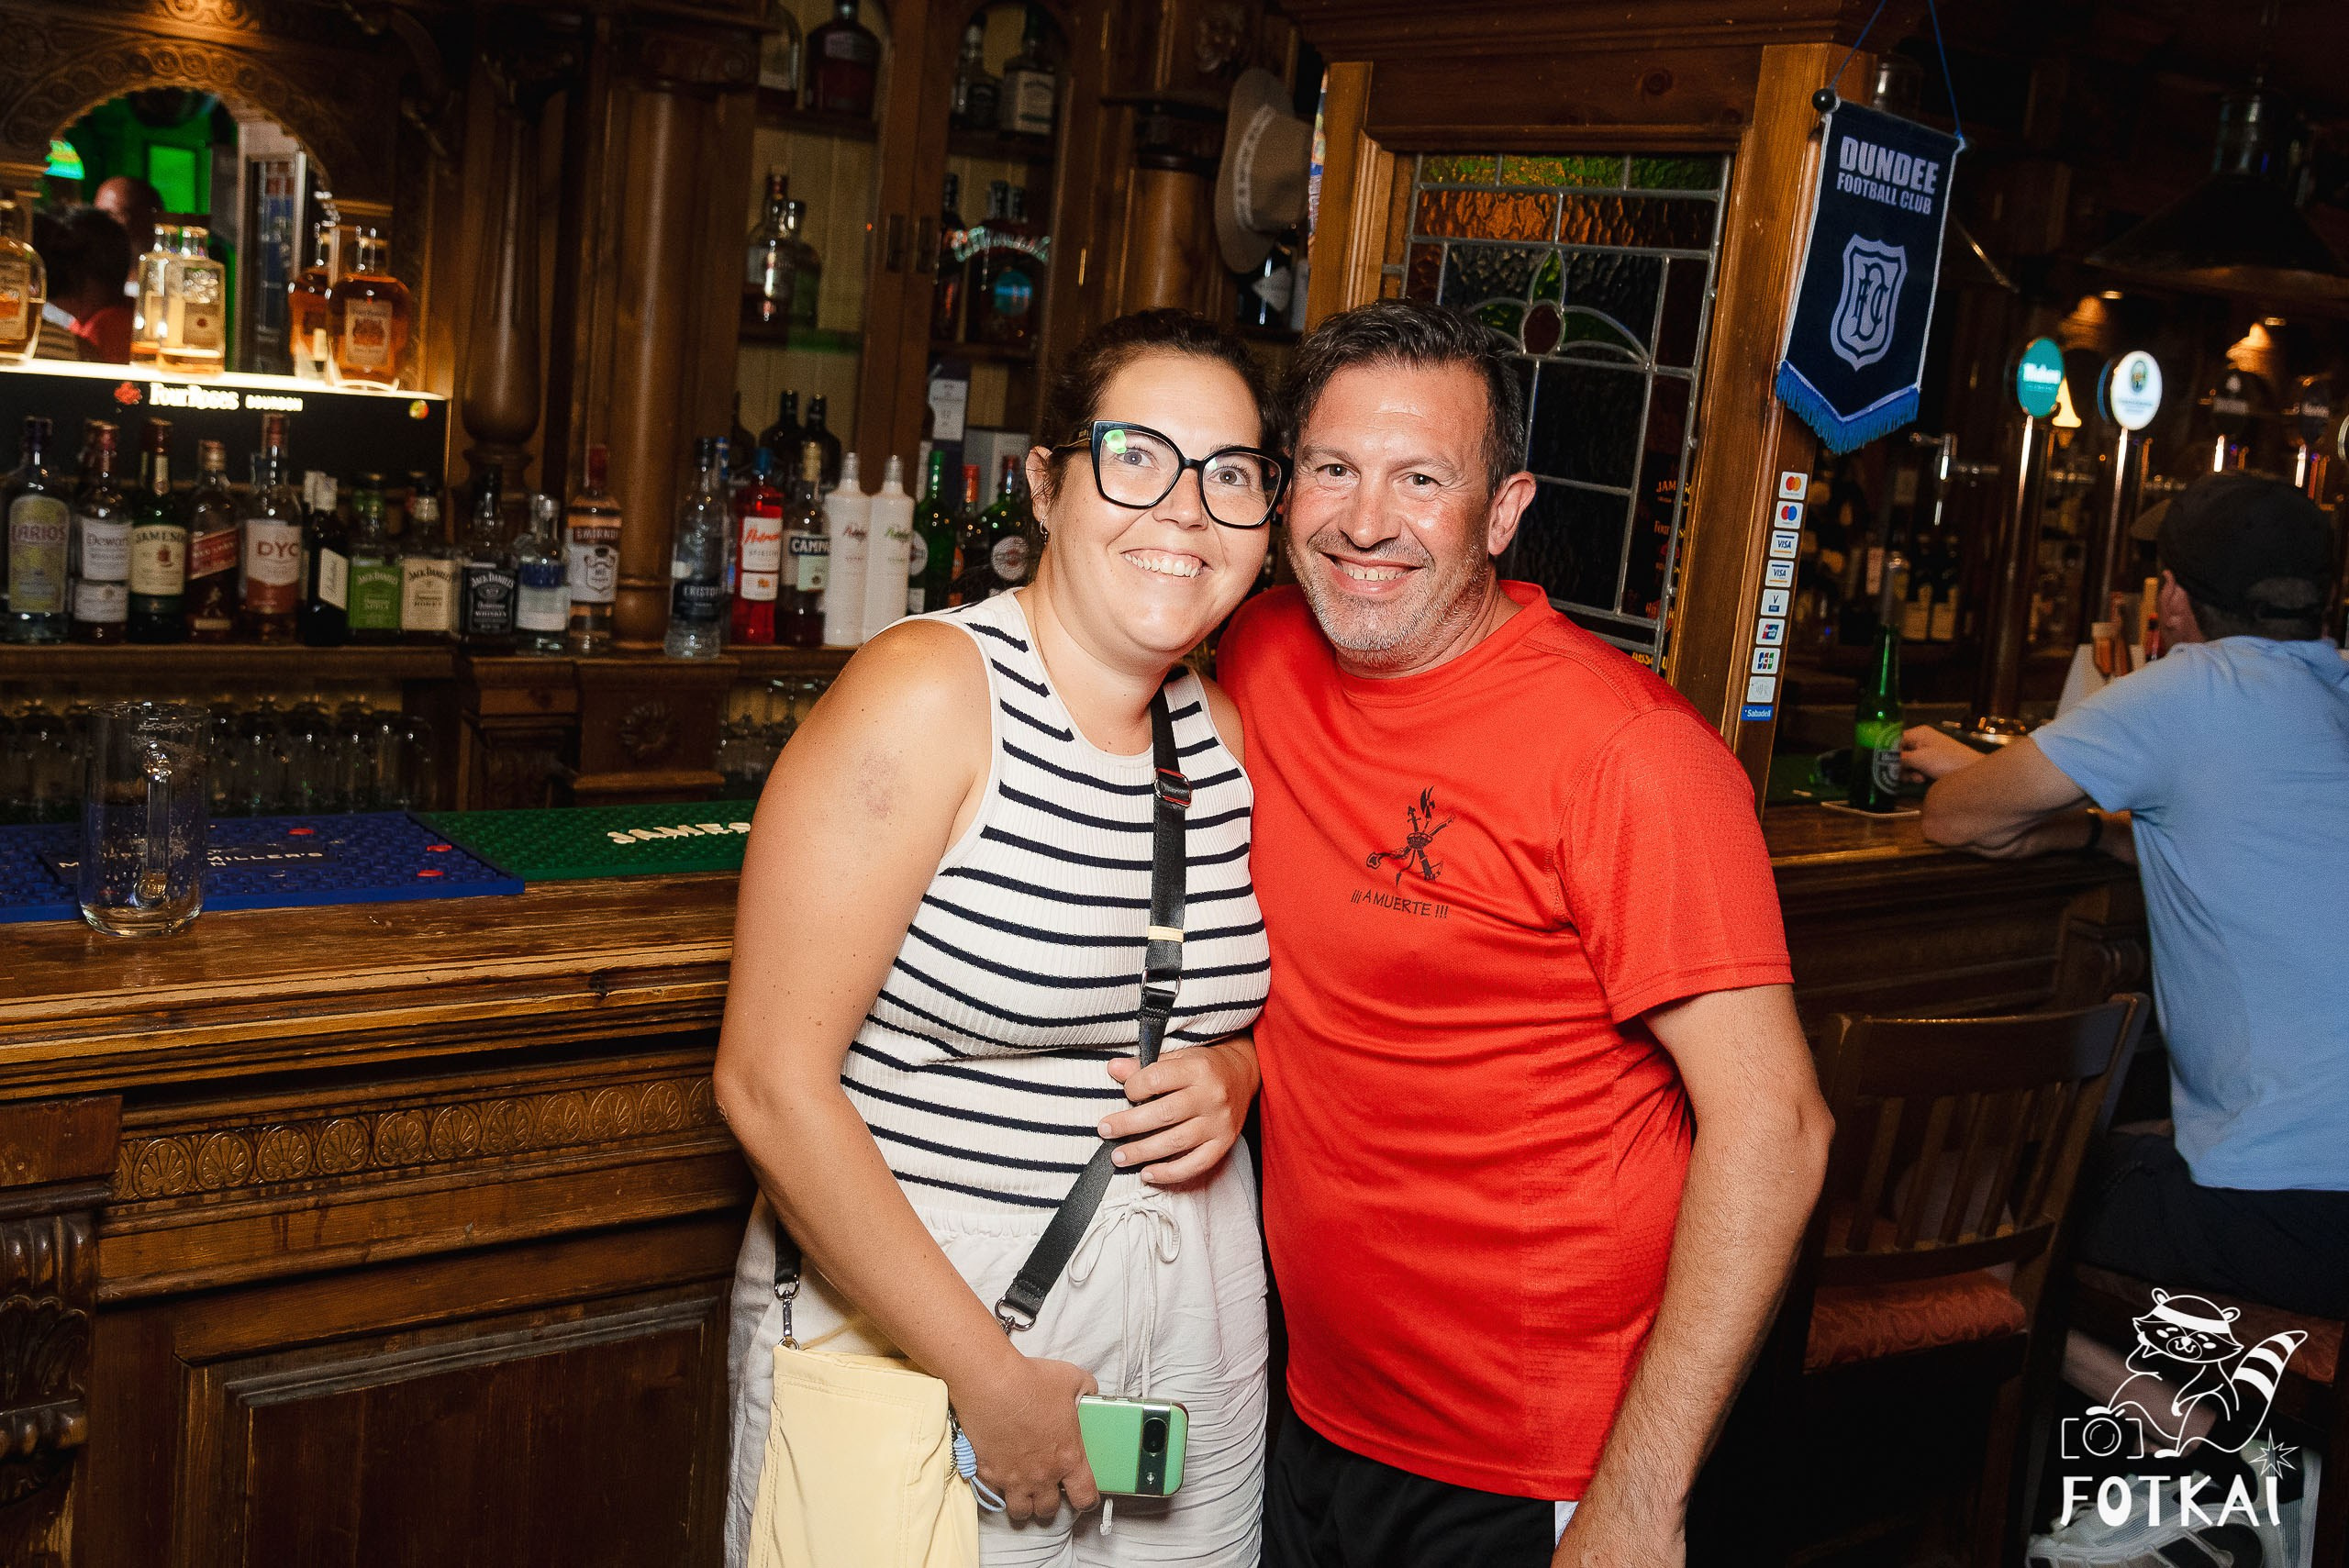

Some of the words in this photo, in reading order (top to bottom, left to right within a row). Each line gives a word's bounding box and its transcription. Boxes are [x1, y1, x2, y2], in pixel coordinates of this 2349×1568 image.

[1839, 136, 1939, 195] DUNDEE
[1837, 172, 1898, 206] FOOTBALL
[1899, 190, 1932, 216] CLUB
[257, 540, 299, 558] DYC
[1777, 539, 1792, 550] VISA
[471, 574, 488, 587] JACK
[1773, 568, 1787, 577] VISA
[607, 822, 751, 844] JAMES
[1363, 888, 1372, 903] A
[1373, 891, 1431, 916] MUERTE
